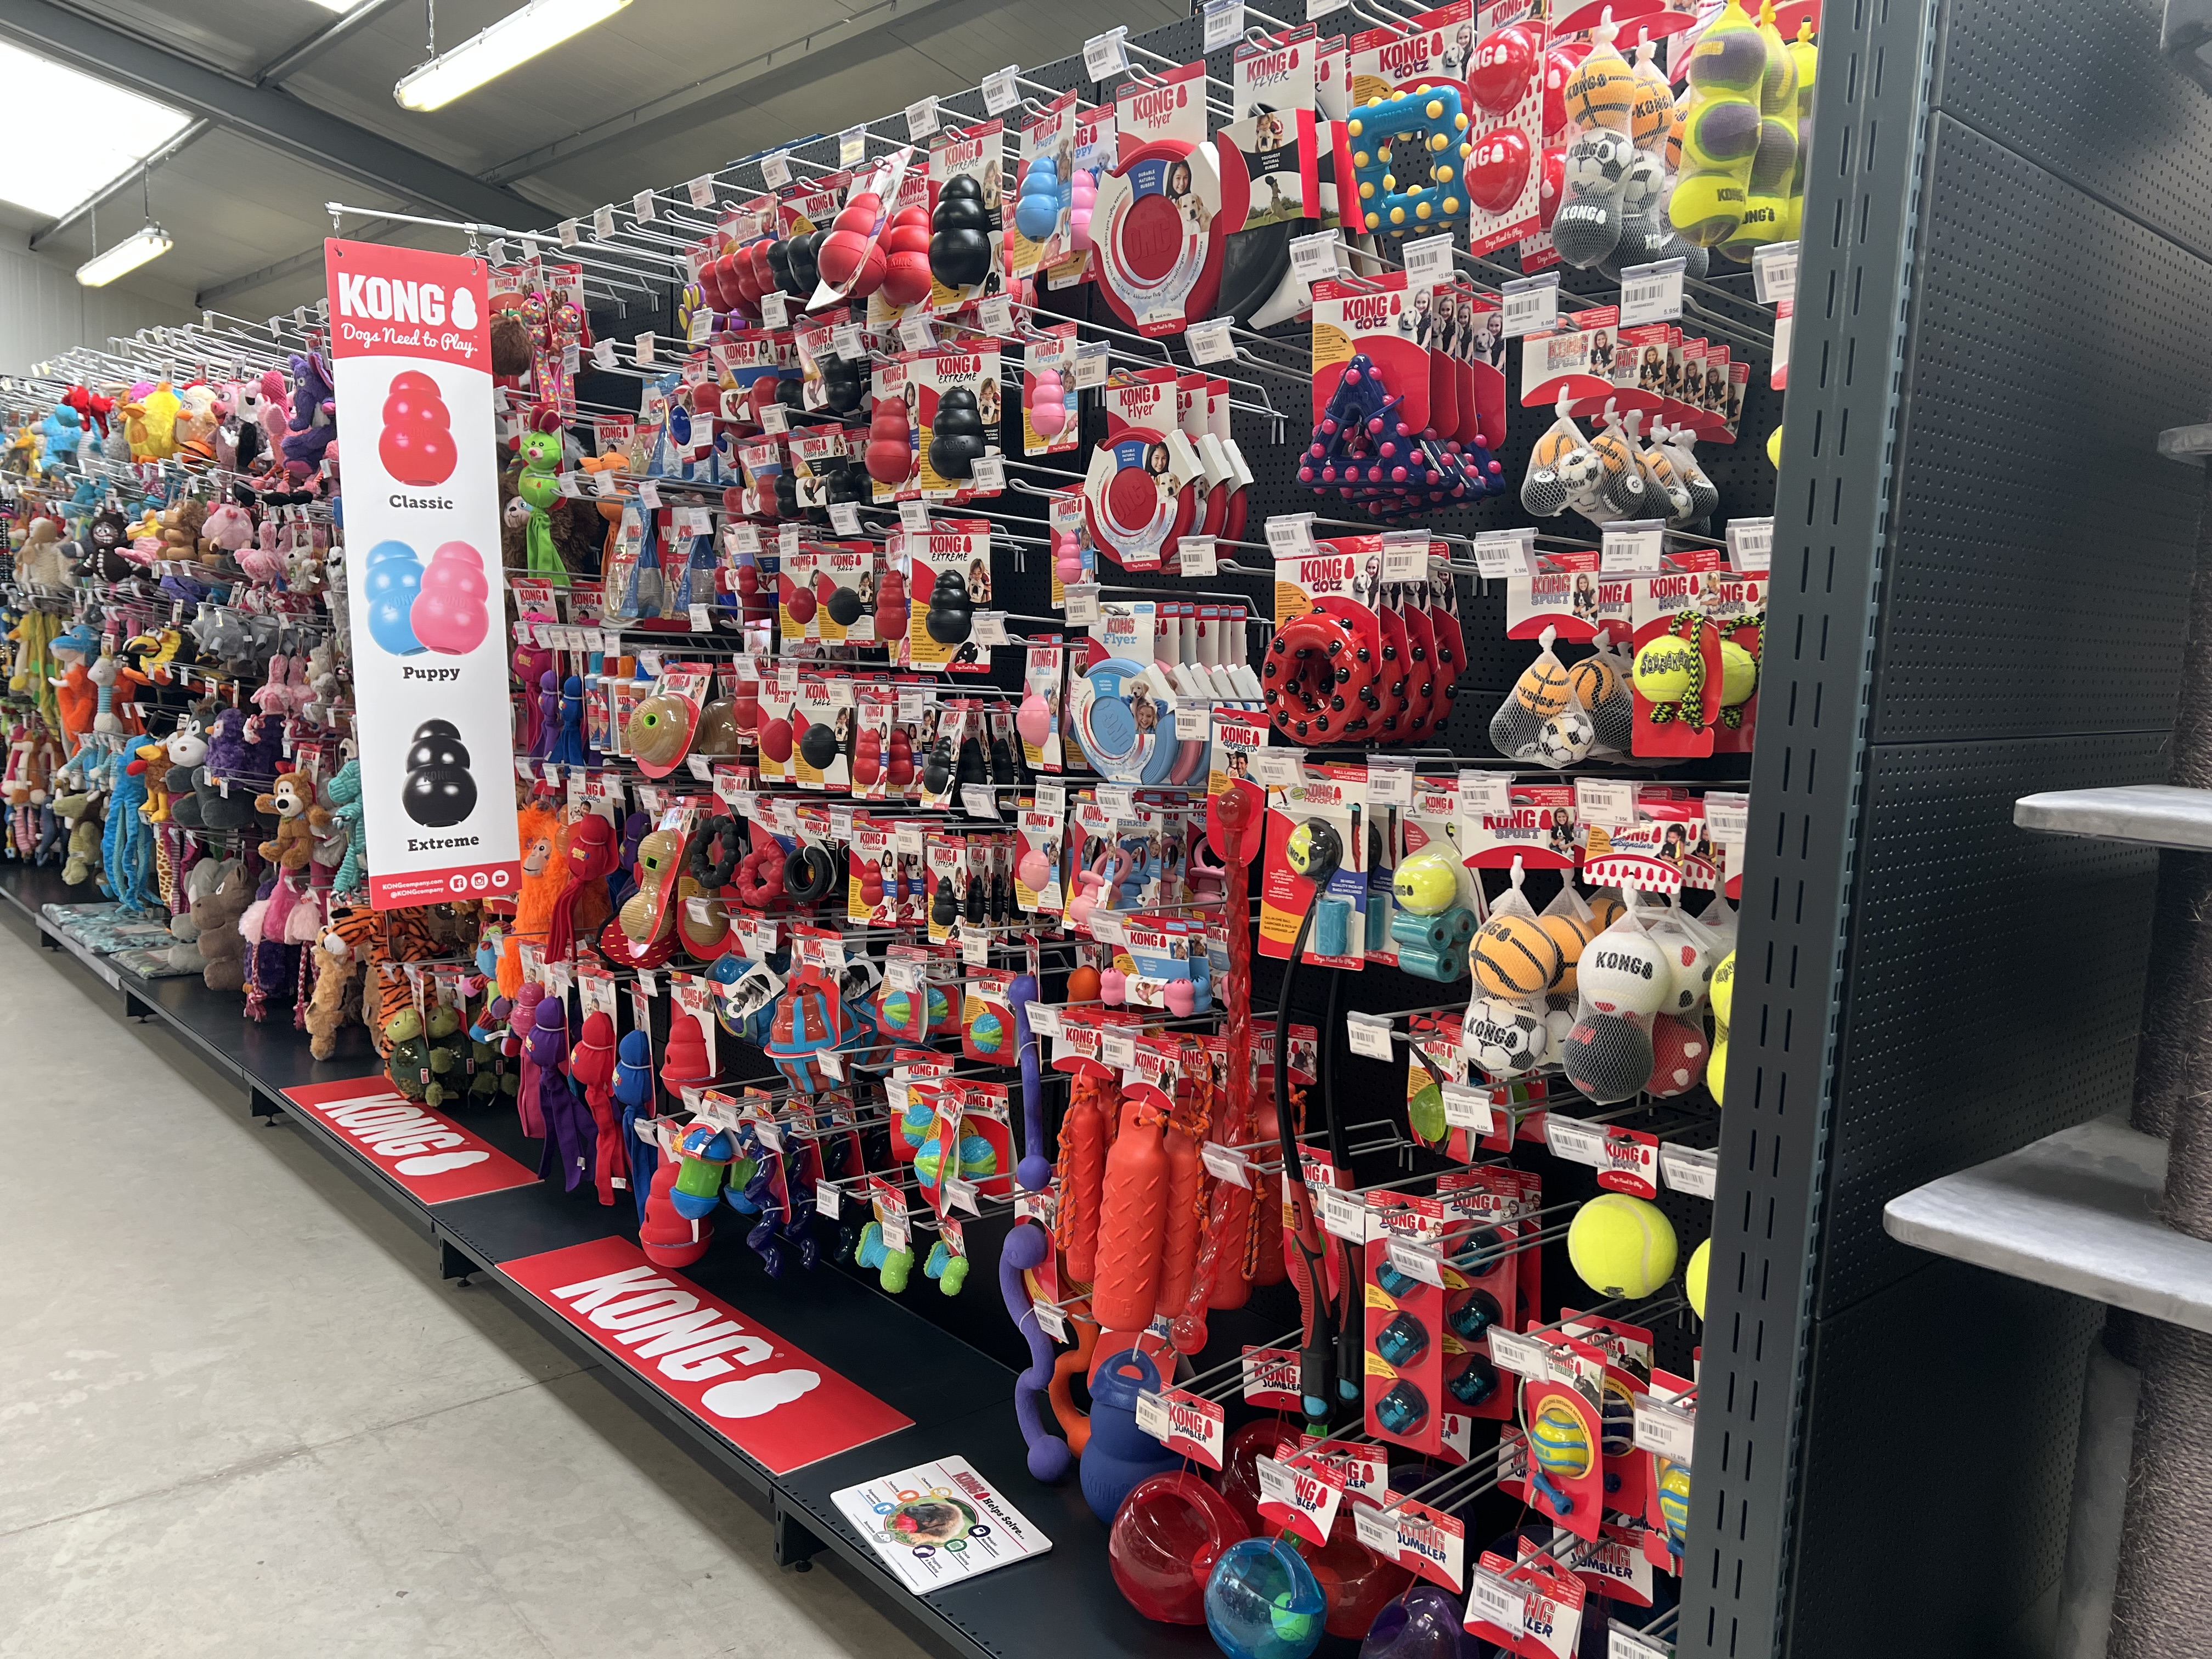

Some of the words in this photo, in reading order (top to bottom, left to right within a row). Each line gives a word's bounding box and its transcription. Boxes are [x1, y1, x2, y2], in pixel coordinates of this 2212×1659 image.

[1379, 35, 1429, 73] KONG
[1246, 52, 1286, 83] KONG
[1393, 57, 1430, 81] dotz
[1252, 70, 1289, 92] FLYER
[1133, 88, 1174, 122] KONG
[1148, 112, 1172, 129] Flyer
[1033, 116, 1056, 145] KONG
[1035, 132, 1057, 151] Puppy
[944, 141, 973, 167] KONG
[946, 156, 979, 174] EXTREME
[1138, 169, 1156, 178] DURABLE
[1138, 175, 1156, 184] NATURAL
[806, 194, 828, 213] KONG
[899, 191, 927, 207] Classic
[1742, 208, 1767, 224] ONG
[337, 272, 445, 326] KONG
[1342, 296, 1387, 321] KONG
[1355, 315, 1388, 331] dotz
[341, 323, 381, 348] Dogs
[382, 327, 421, 347] Need
[422, 335, 438, 348] to
[441, 333, 478, 358] Play.
[806, 330, 828, 349] KONG
[724, 343, 748, 359] KONG
[1035, 341, 1057, 358] KONG
[936, 356, 970, 376] KONG
[1037, 353, 1061, 363] Puppy
[938, 372, 977, 384] EXTREME
[1119, 386, 1150, 407] KONG
[1127, 402, 1155, 420] Flyer
[600, 427, 621, 438] KONG
[803, 439, 821, 454] KONG
[1632, 478, 1639, 489] 8
[389, 494, 453, 510] Classic
[1058, 500, 1077, 516] KONG
[929, 535, 962, 554] KONG
[790, 555, 811, 567] KONG
[830, 554, 854, 567] KONG
[932, 551, 968, 563] EXTREME
[836, 563, 854, 572] BALL
[1301, 558, 1342, 583] KONG
[1312, 578, 1342, 593] dotz
[1531, 574, 1571, 595] KONG
[1650, 576, 1687, 599] KONG
[1531, 591, 1570, 606] SPORT
[1720, 583, 1743, 603] NG
[1107, 618, 1135, 634] KONG
[1103, 633, 1137, 647] Flyer
[1031, 650, 1052, 668] KONG
[402, 666, 460, 681] Puppy
[1036, 666, 1050, 675] Ball
[774, 693, 789, 703] Ball
[805, 684, 829, 699] KON
[1221, 725, 1250, 745] KONG
[579, 794, 601, 803] Wubba
[1425, 796, 1447, 809] KONG
[1025, 812, 1047, 826] KONG
[1085, 819, 1106, 828] Binkie
[1117, 819, 1148, 827] Binkie
[860, 832, 881, 844] KONG
[1495, 827, 1541, 839] SPORT
[408, 835, 479, 851] Extreme
[862, 843, 883, 851] Classic
[934, 848, 952, 861] KONG
[382, 878, 443, 890] KONGcompany.com
[390, 885, 444, 899] @KONGcompany
[1130, 932, 1158, 946] KONG
[1313, 955, 1325, 964] Dogs
[1595, 951, 1643, 975] KONG
[979, 981, 996, 991] KONG
[1066, 1027, 1093, 1045] KONG
[1467, 1016, 1509, 1043] KONG
[1073, 1040, 1095, 1051] Training
[1075, 1047, 1093, 1057] Dummy
[1136, 1052, 1159, 1071] KONG
[1181, 1050, 1203, 1065] ONG
[908, 1064, 932, 1076] KONG
[314, 1091, 466, 1158] KONG
[550, 1265, 774, 1382] KONG
[1262, 1379, 1302, 1391] JUMBLER
[1170, 1404, 1203, 1433] KONG
[1175, 1422, 1207, 1443] JUMBLER
[1295, 1474, 1317, 1502] NG
[952, 1471, 986, 1496] KONG
[982, 1497, 1006, 1523] Helps
[1001, 1515, 1025, 1540] Solve...
[1397, 1530, 1447, 1564] JUMBLER
[1570, 1551, 1633, 1579] JUMBLER
[1523, 1590, 1556, 1626] NG
